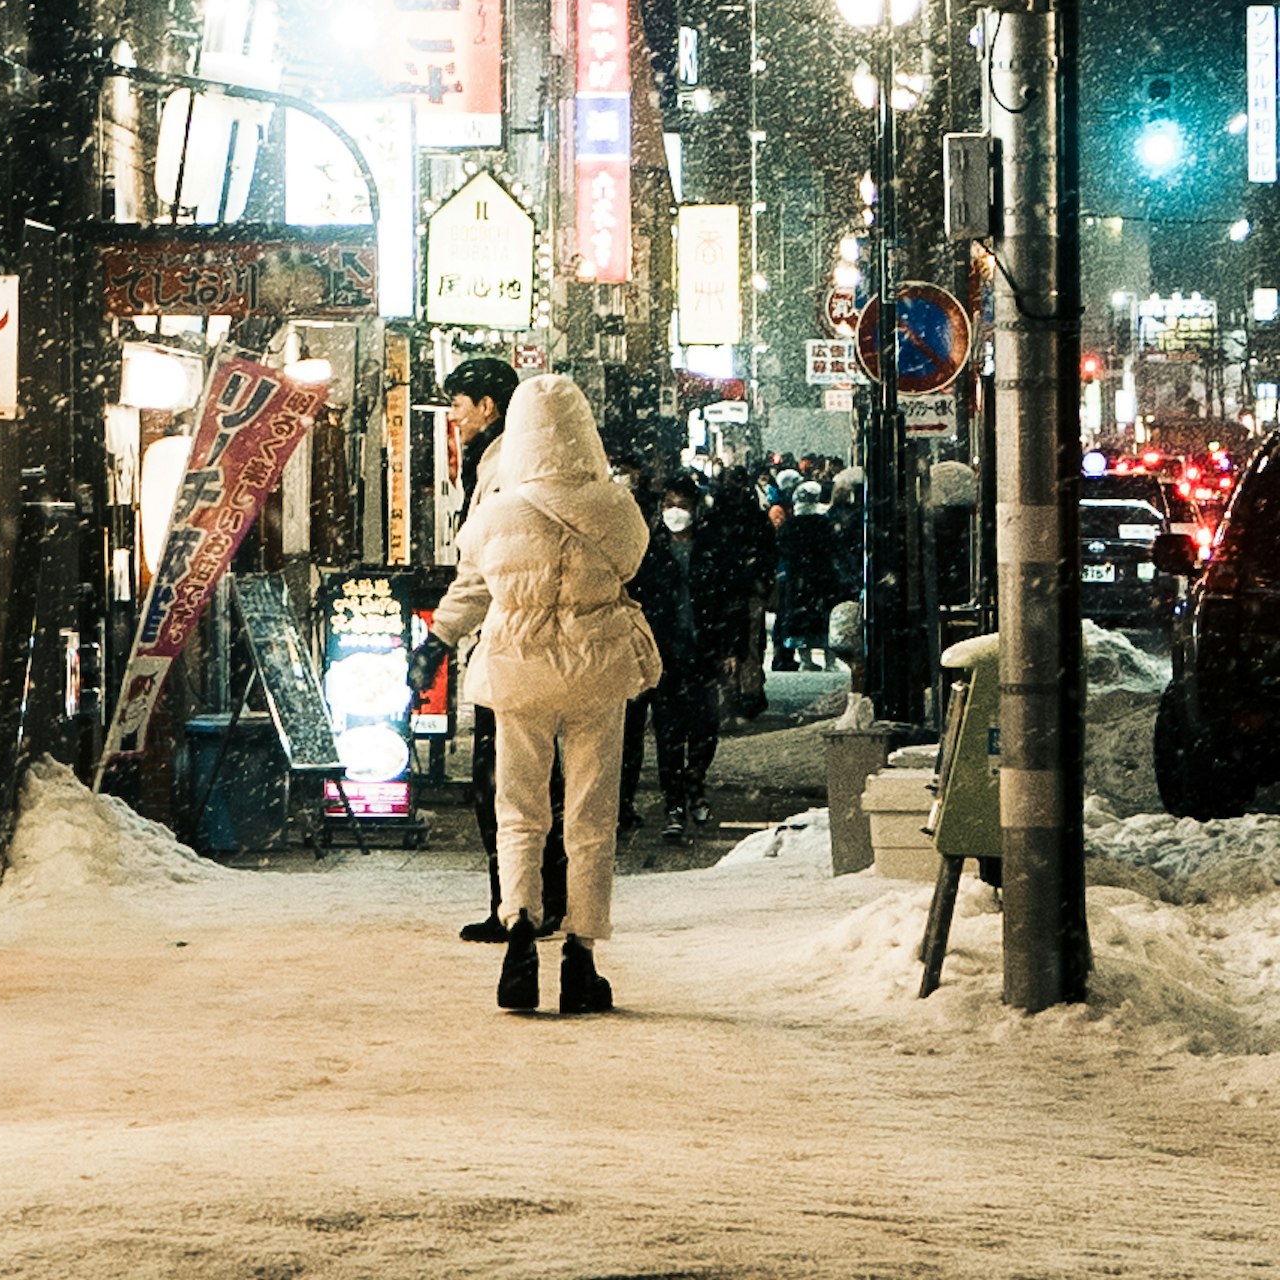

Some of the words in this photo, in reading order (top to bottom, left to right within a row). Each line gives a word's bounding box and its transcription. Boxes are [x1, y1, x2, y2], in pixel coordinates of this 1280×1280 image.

[111, 260, 260, 312] てしお川
[437, 272, 523, 300] 居心地
[811, 343, 854, 359] 広告
